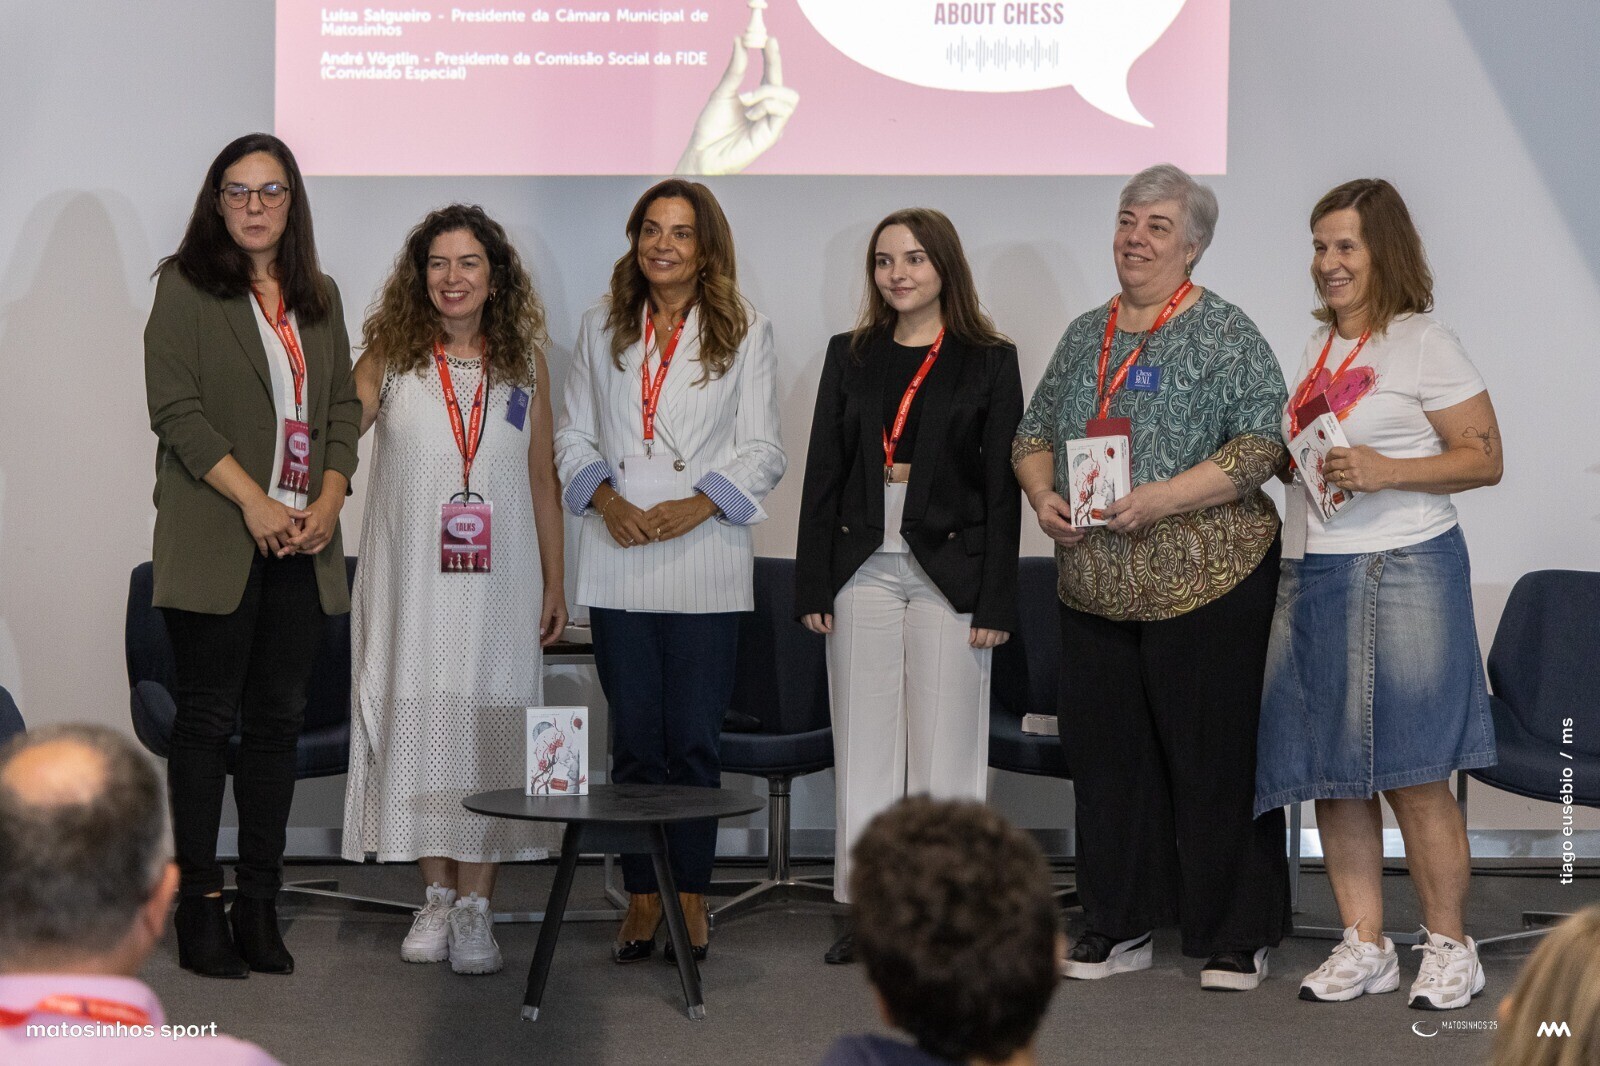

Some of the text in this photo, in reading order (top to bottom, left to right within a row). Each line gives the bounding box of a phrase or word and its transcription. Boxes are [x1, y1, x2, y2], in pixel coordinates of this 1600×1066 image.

[364, 8, 432, 25] Salgueiro
[451, 8, 526, 22] Presidente
[531, 8, 549, 22] da
[556, 8, 610, 22] Câmara
[616, 8, 684, 24] Municipal
[690, 8, 709, 22] de
[934, 2, 1065, 25] ABOUT CHESS
[321, 23, 403, 36] Matosinhos
[320, 51, 364, 65] André
[435, 51, 509, 65] Presidente
[513, 51, 531, 65] da
[534, 51, 604, 65] Comissão
[608, 51, 650, 65] Social
[653, 51, 672, 65] da
[675, 51, 708, 65] FIDE
[320, 66, 467, 82] (Convidado Especial)
[455, 522, 476, 532] TALKS
